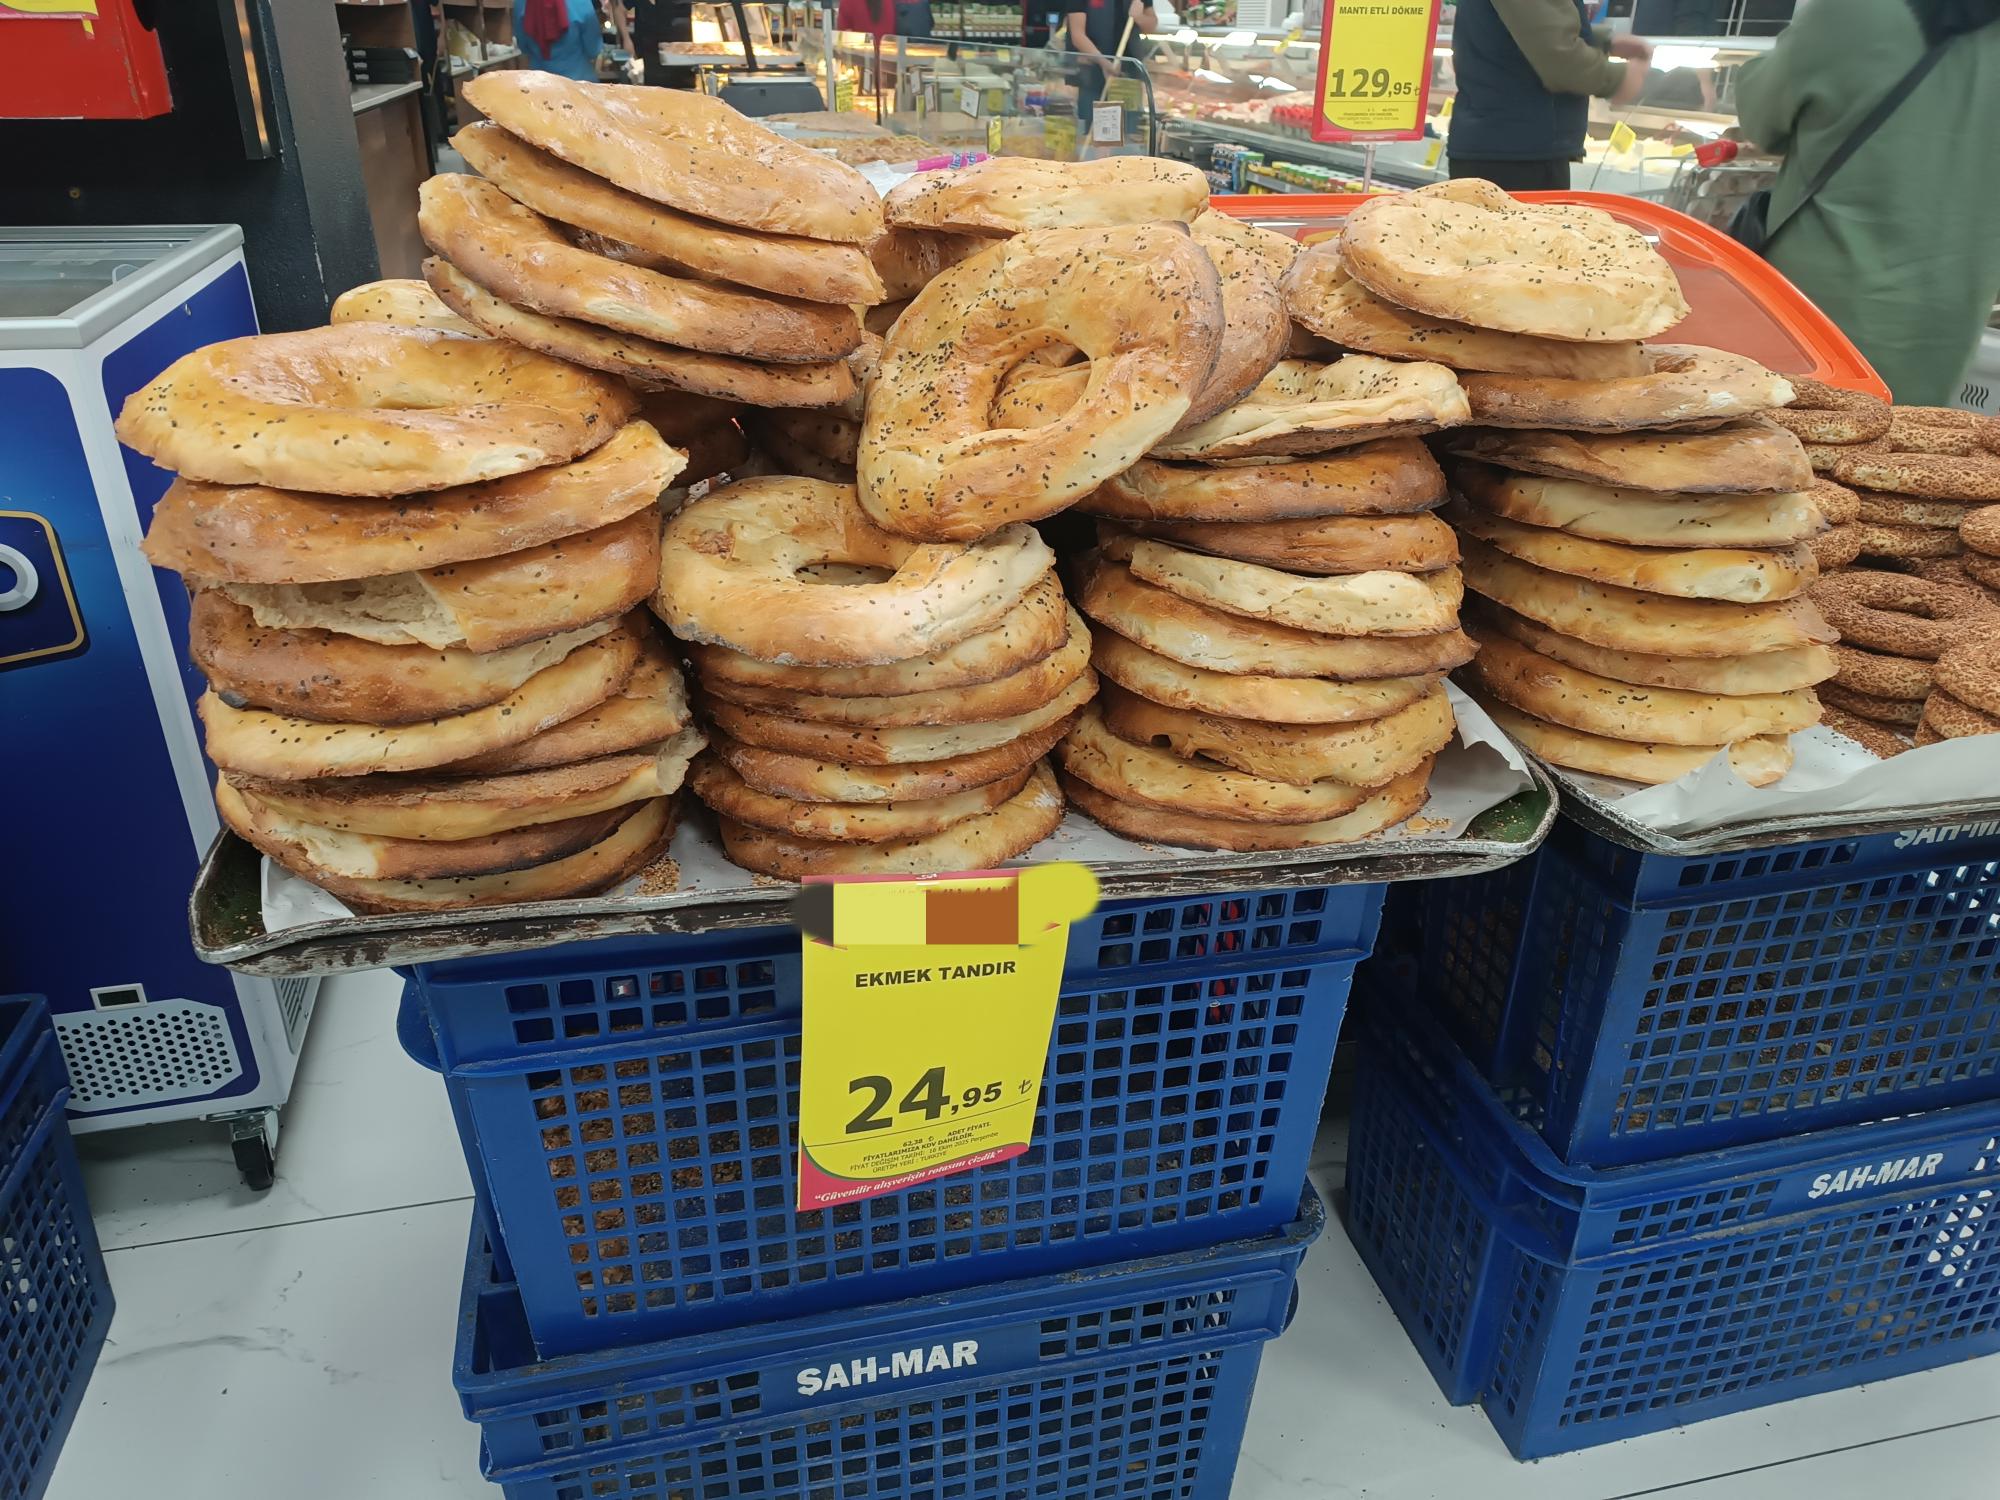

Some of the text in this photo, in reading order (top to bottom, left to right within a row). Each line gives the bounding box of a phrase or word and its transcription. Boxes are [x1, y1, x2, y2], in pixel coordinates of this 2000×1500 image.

[1339, 5, 1424, 15] MANTI ETLİ DÖKME
[1329, 68, 1412, 98] 129,95
[1894, 820, 2000, 850] SAH-M
[855, 960, 1016, 988] EKMEK TANDIR
[845, 1066, 1002, 1135] 24,95
[947, 1129, 965, 1137] ADET
[850, 1163, 869, 1171] FİYAT
[938, 1143, 953, 1152] Ekim
[954, 1139, 969, 1148] 2025
[863, 1145, 920, 1162] FİYATLARIMIZA
[921, 1141, 937, 1150] KDV
[873, 1167, 926, 1190] alışverişin
[928, 1160, 966, 1176] rotasını
[1807, 1152, 1944, 1200] SAH-MAR
[796, 1340, 979, 1397] SAH-MAR
